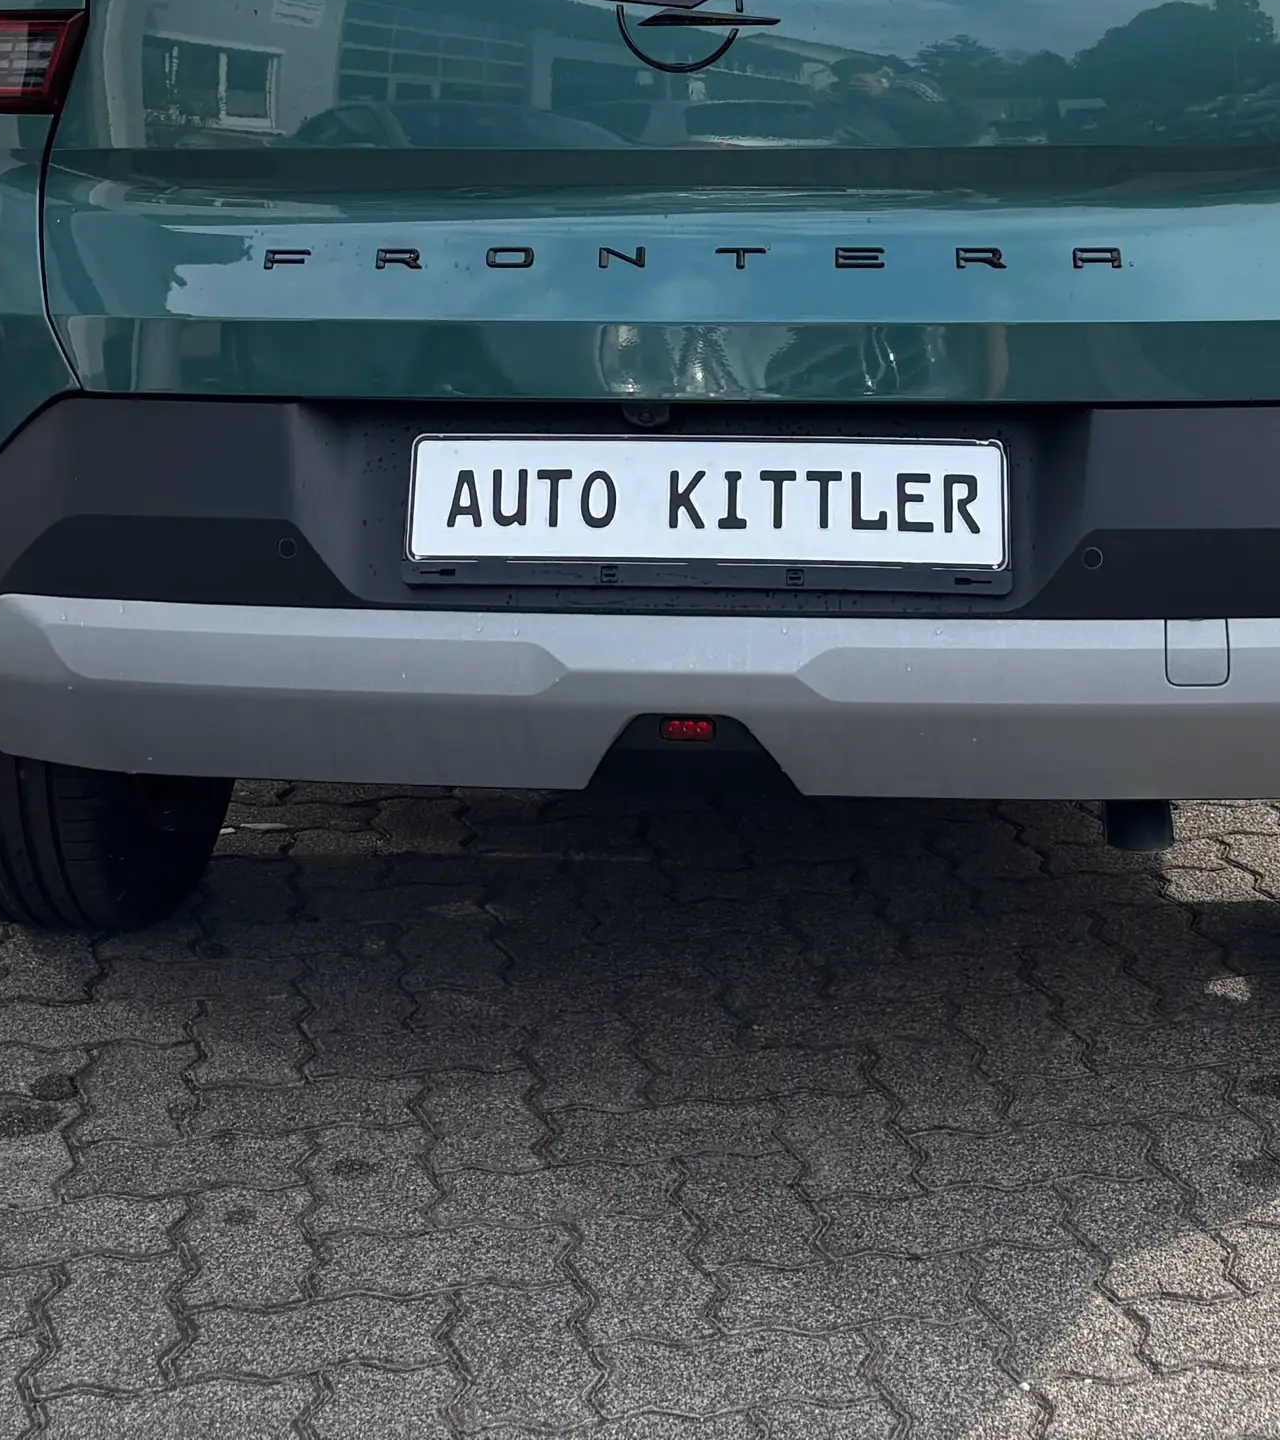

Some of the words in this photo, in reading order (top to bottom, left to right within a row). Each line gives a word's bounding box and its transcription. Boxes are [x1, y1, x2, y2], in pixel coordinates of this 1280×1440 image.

[262, 245, 1125, 269] FRONTERA
[446, 468, 619, 529] AUTO
[668, 469, 983, 535] KITTLER
